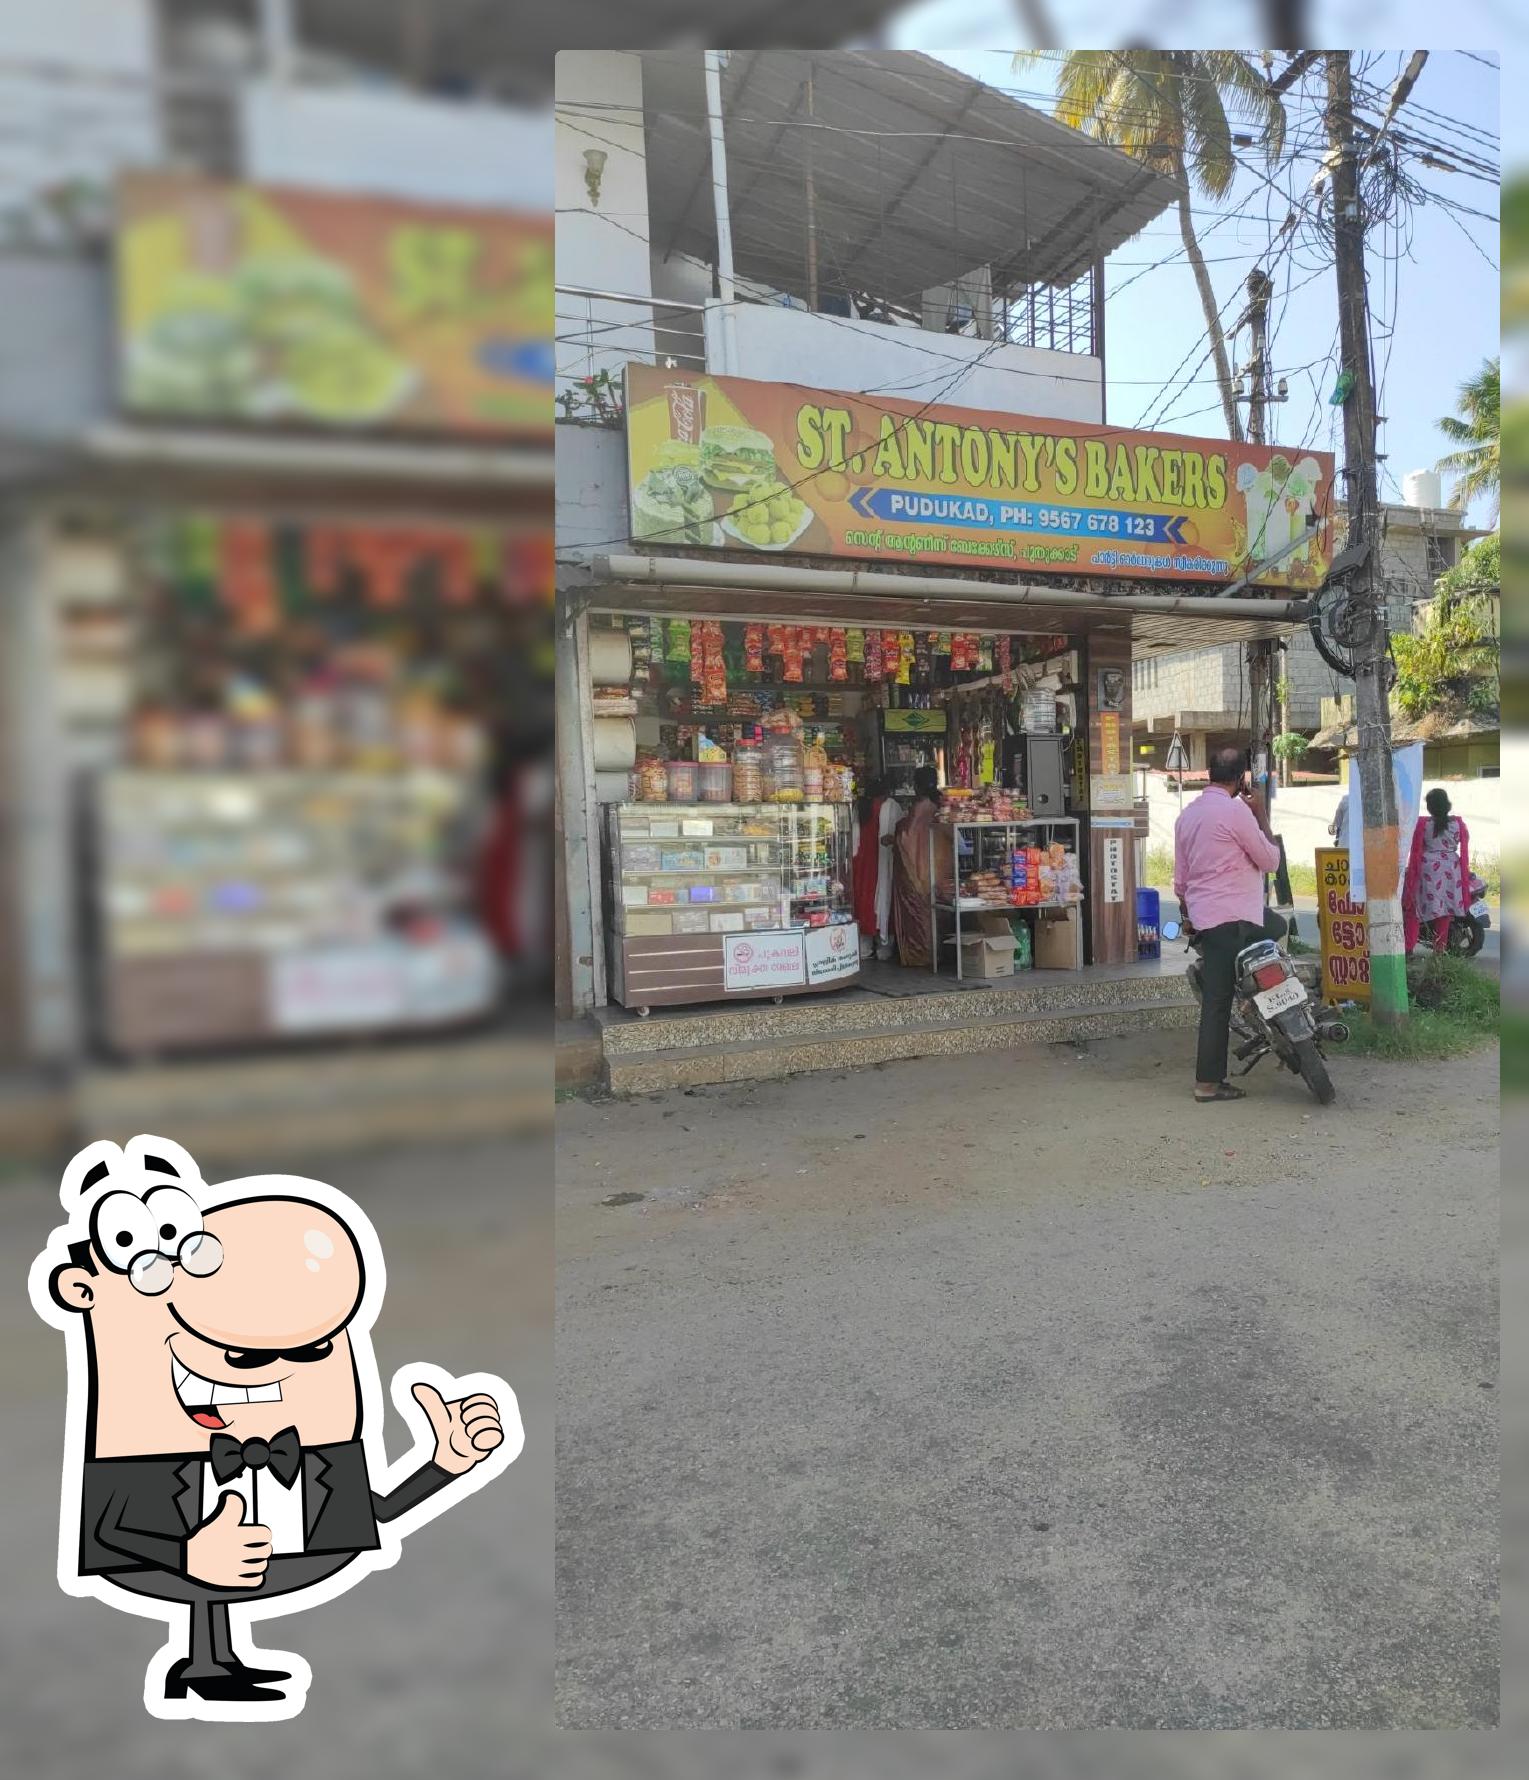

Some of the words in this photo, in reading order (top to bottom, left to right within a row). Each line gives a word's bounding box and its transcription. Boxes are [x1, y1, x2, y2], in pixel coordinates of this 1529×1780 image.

[796, 403, 865, 475] ST.
[871, 414, 1079, 496] ANTONY'S
[1084, 439, 1228, 510] BAKERS
[890, 494, 994, 528] PUDUKAD,
[1000, 505, 1034, 527] PH:
[1038, 509, 1082, 531] 9567
[1087, 514, 1120, 533] 678
[1125, 517, 1156, 537] 123
[1109, 839, 1119, 902] PHOTOSTAT
[1324, 859, 1350, 872] ചാ
